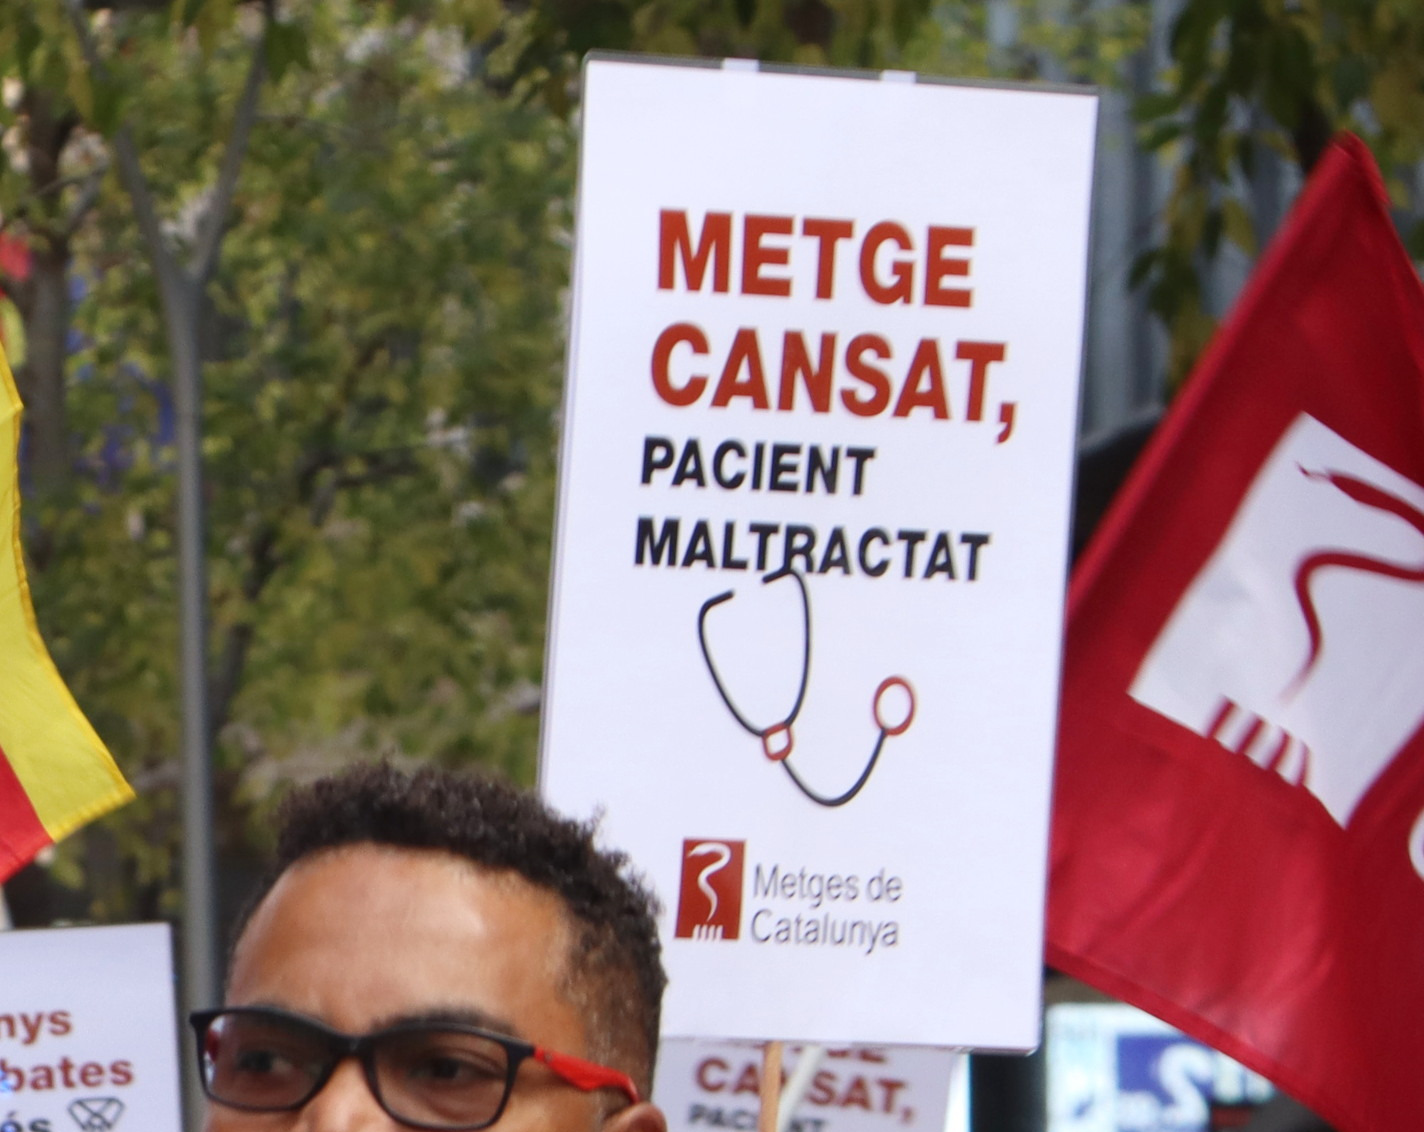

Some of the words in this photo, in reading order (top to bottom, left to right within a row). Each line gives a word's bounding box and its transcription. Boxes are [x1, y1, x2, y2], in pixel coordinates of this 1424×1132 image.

[657, 209, 975, 308] METGE
[651, 321, 1018, 444] CANSAT,
[640, 434, 877, 497] PACIENT
[634, 515, 991, 581] MALTRACTAT
[753, 863, 860, 909] Metges
[867, 868, 904, 902] de
[750, 908, 899, 956] Catalunya
[695, 1056, 915, 1126] CASAT,
